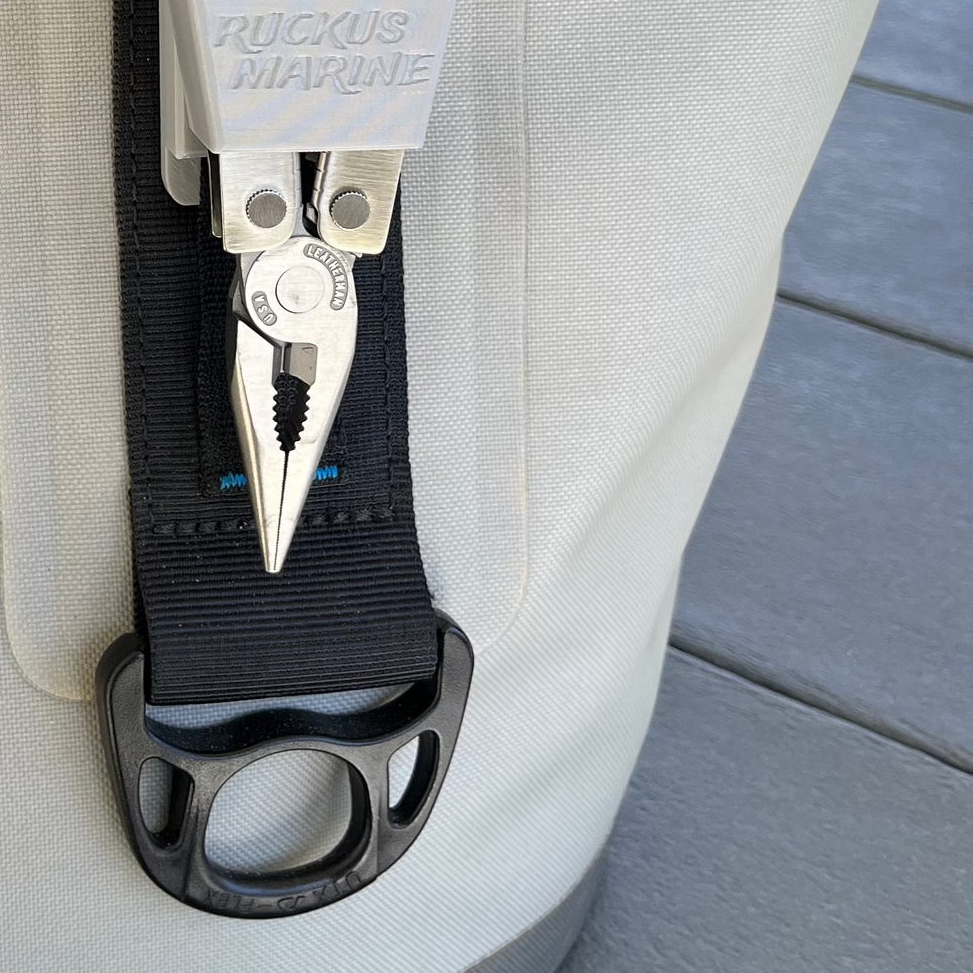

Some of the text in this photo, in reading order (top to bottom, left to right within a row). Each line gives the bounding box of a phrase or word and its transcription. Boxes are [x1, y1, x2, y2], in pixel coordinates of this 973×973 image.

[214, 10, 410, 55] RUCKUS
[231, 51, 436, 95] MARINE
[307, 245, 347, 307] LEATHERMAN
[254, 294, 274, 323] USA
